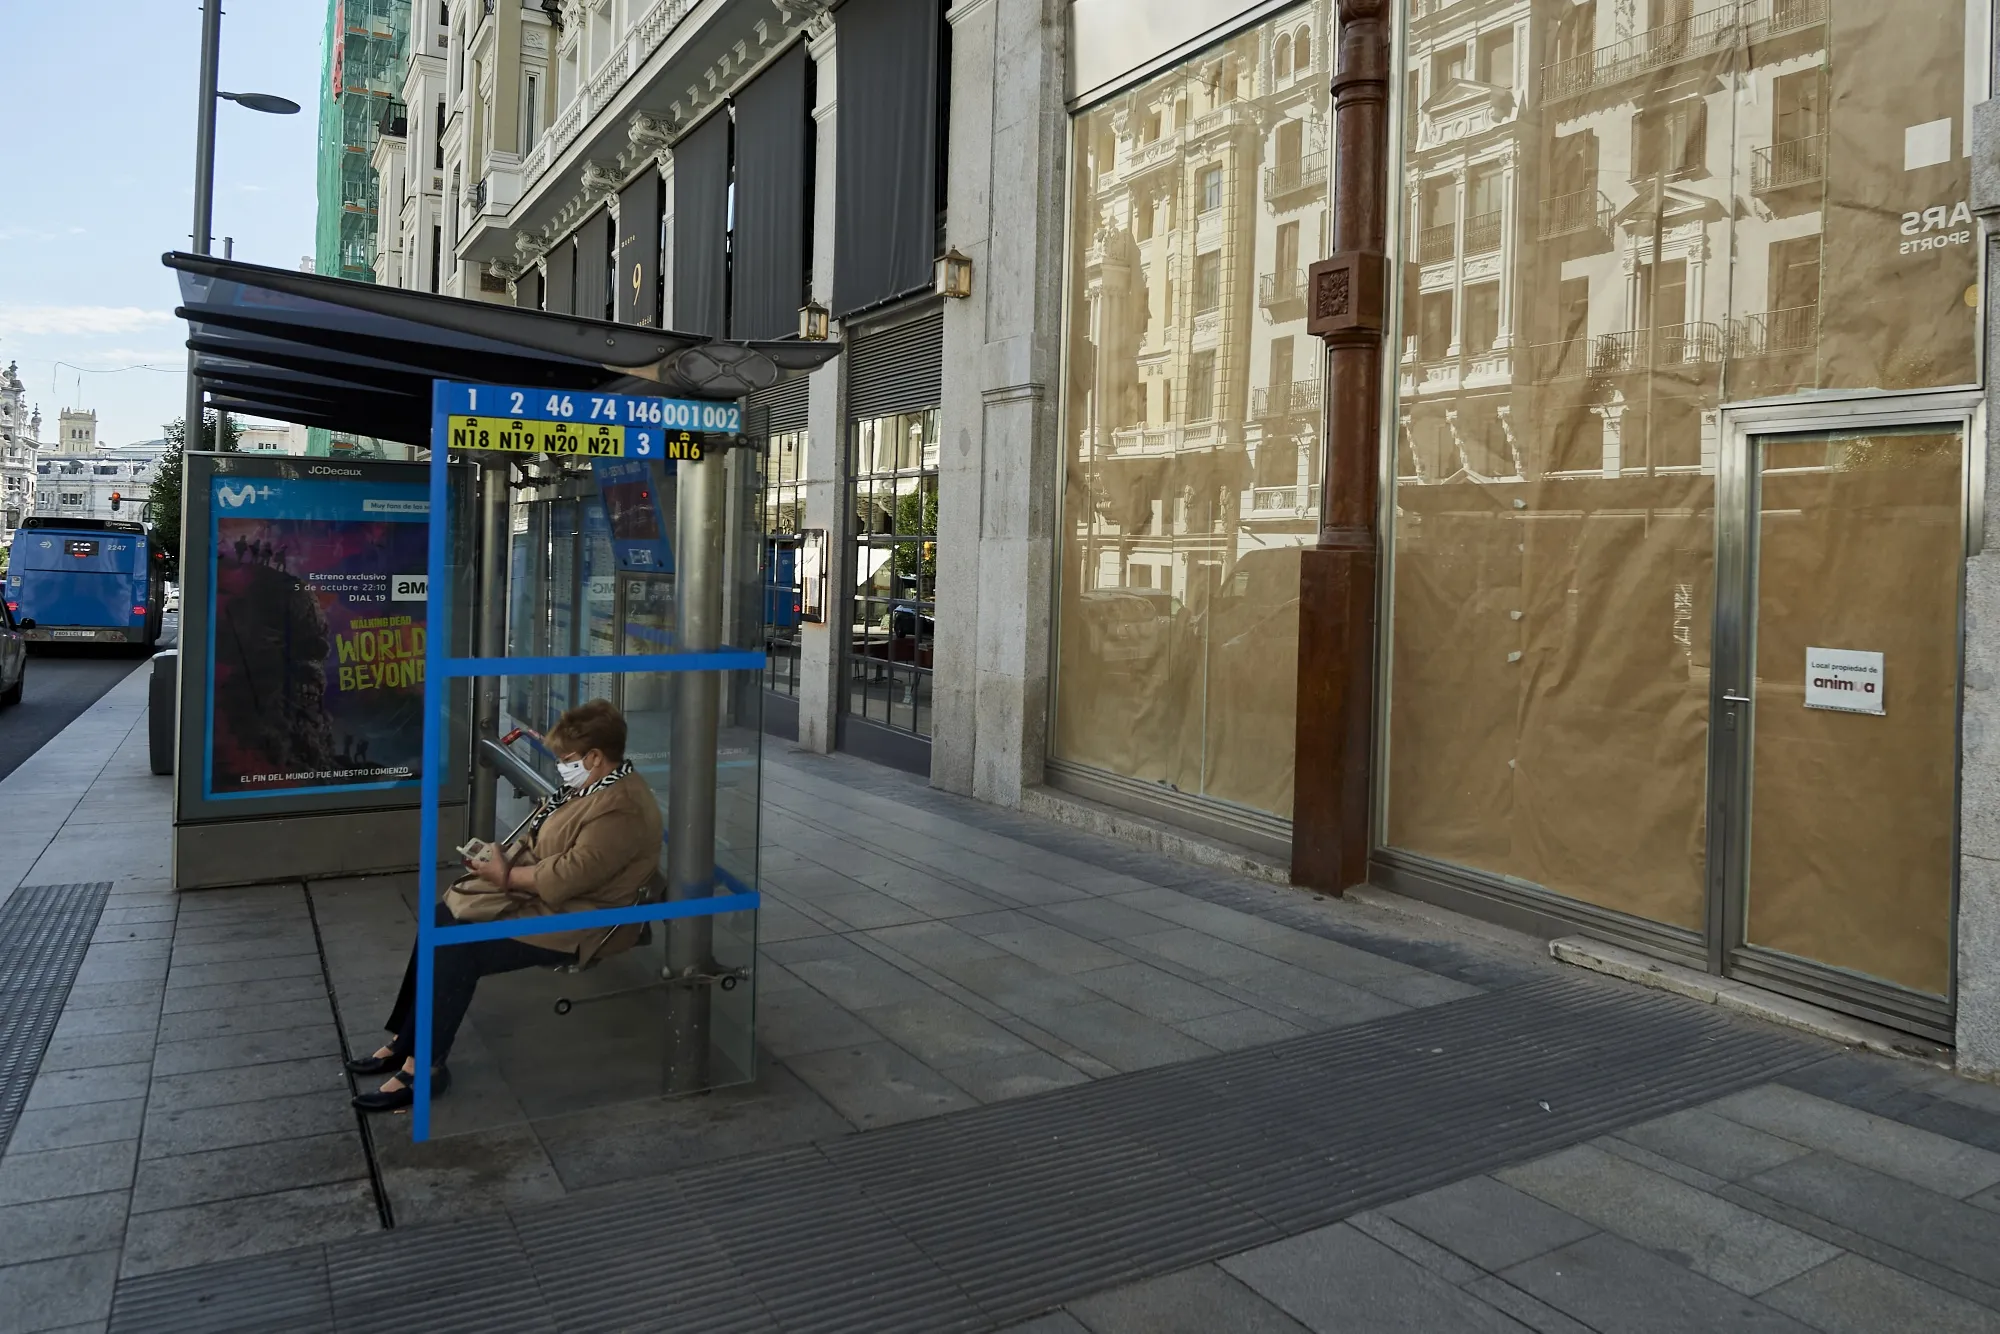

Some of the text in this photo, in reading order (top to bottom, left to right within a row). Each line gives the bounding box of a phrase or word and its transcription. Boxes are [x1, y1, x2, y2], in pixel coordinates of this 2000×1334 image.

[467, 388, 739, 430] 1 2 46 74 146 001 002
[453, 428, 700, 460] N18 N19 N20 N21 3 N16
[308, 465, 362, 477] JCDecaux
[370, 502, 386, 511] Muy
[309, 572, 387, 581] Estreno exclusivo
[304, 583, 317, 591] de
[320, 583, 359, 591] octubre
[397, 581, 428, 594] aM
[349, 594, 386, 602] DIAL 19
[350, 615, 412, 630] WALKING DEAD
[336, 627, 427, 663] WORLD
[1811, 661, 1830, 669] Local
[1831, 664, 1867, 673] propiedad
[240, 766, 409, 783] EL FIN DEL MUNDO FUE NUESTRO COMIENZO
